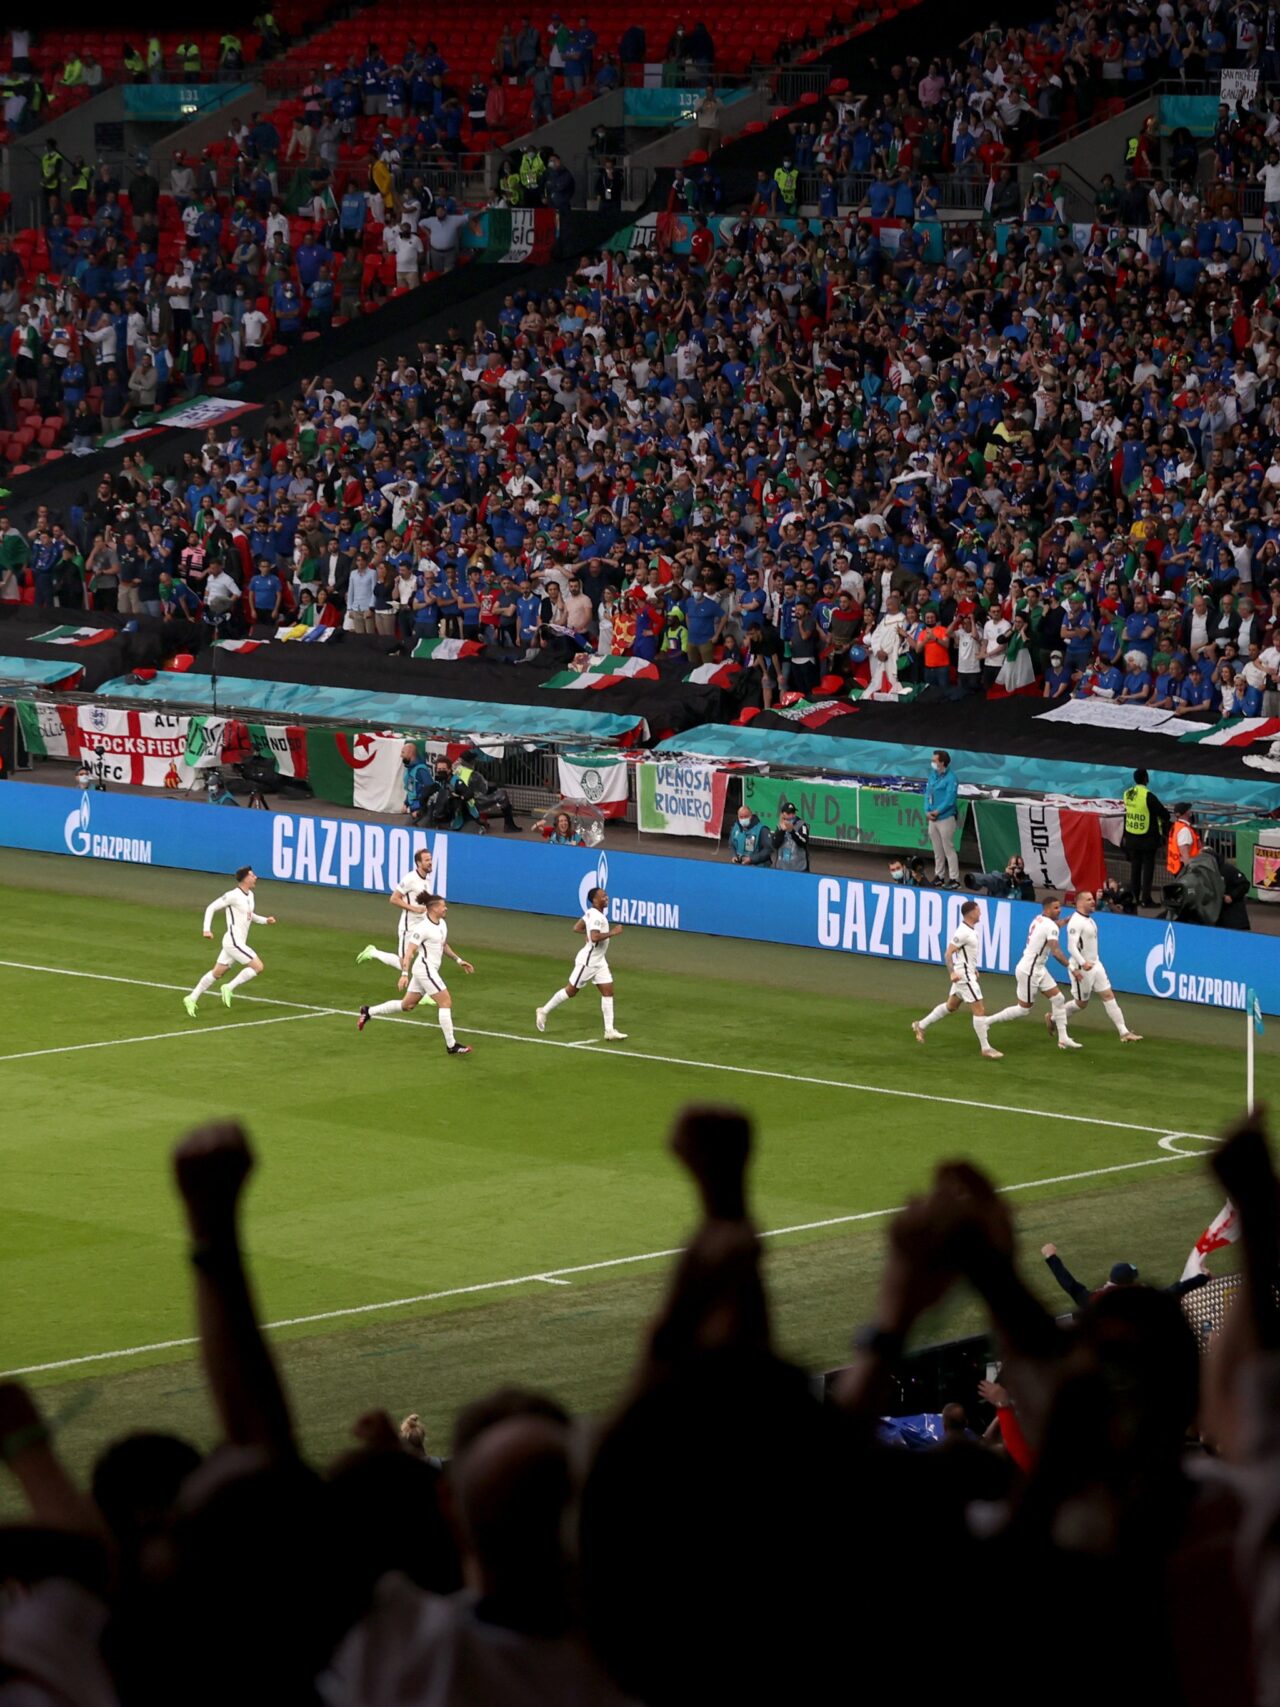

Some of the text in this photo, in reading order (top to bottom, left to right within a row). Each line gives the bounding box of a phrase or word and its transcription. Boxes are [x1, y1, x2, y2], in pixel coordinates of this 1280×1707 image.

[180, 90, 199, 101] 131
[656, 764, 712, 793] VENOSA
[655, 793, 712, 820] RIONERO
[873, 793, 899, 807] THE
[92, 834, 152, 864] GAZPROM
[272, 814, 449, 900] GAZPROM
[612, 897, 679, 930] GAZPROM
[1178, 974, 1247, 1010] GAZPROM
